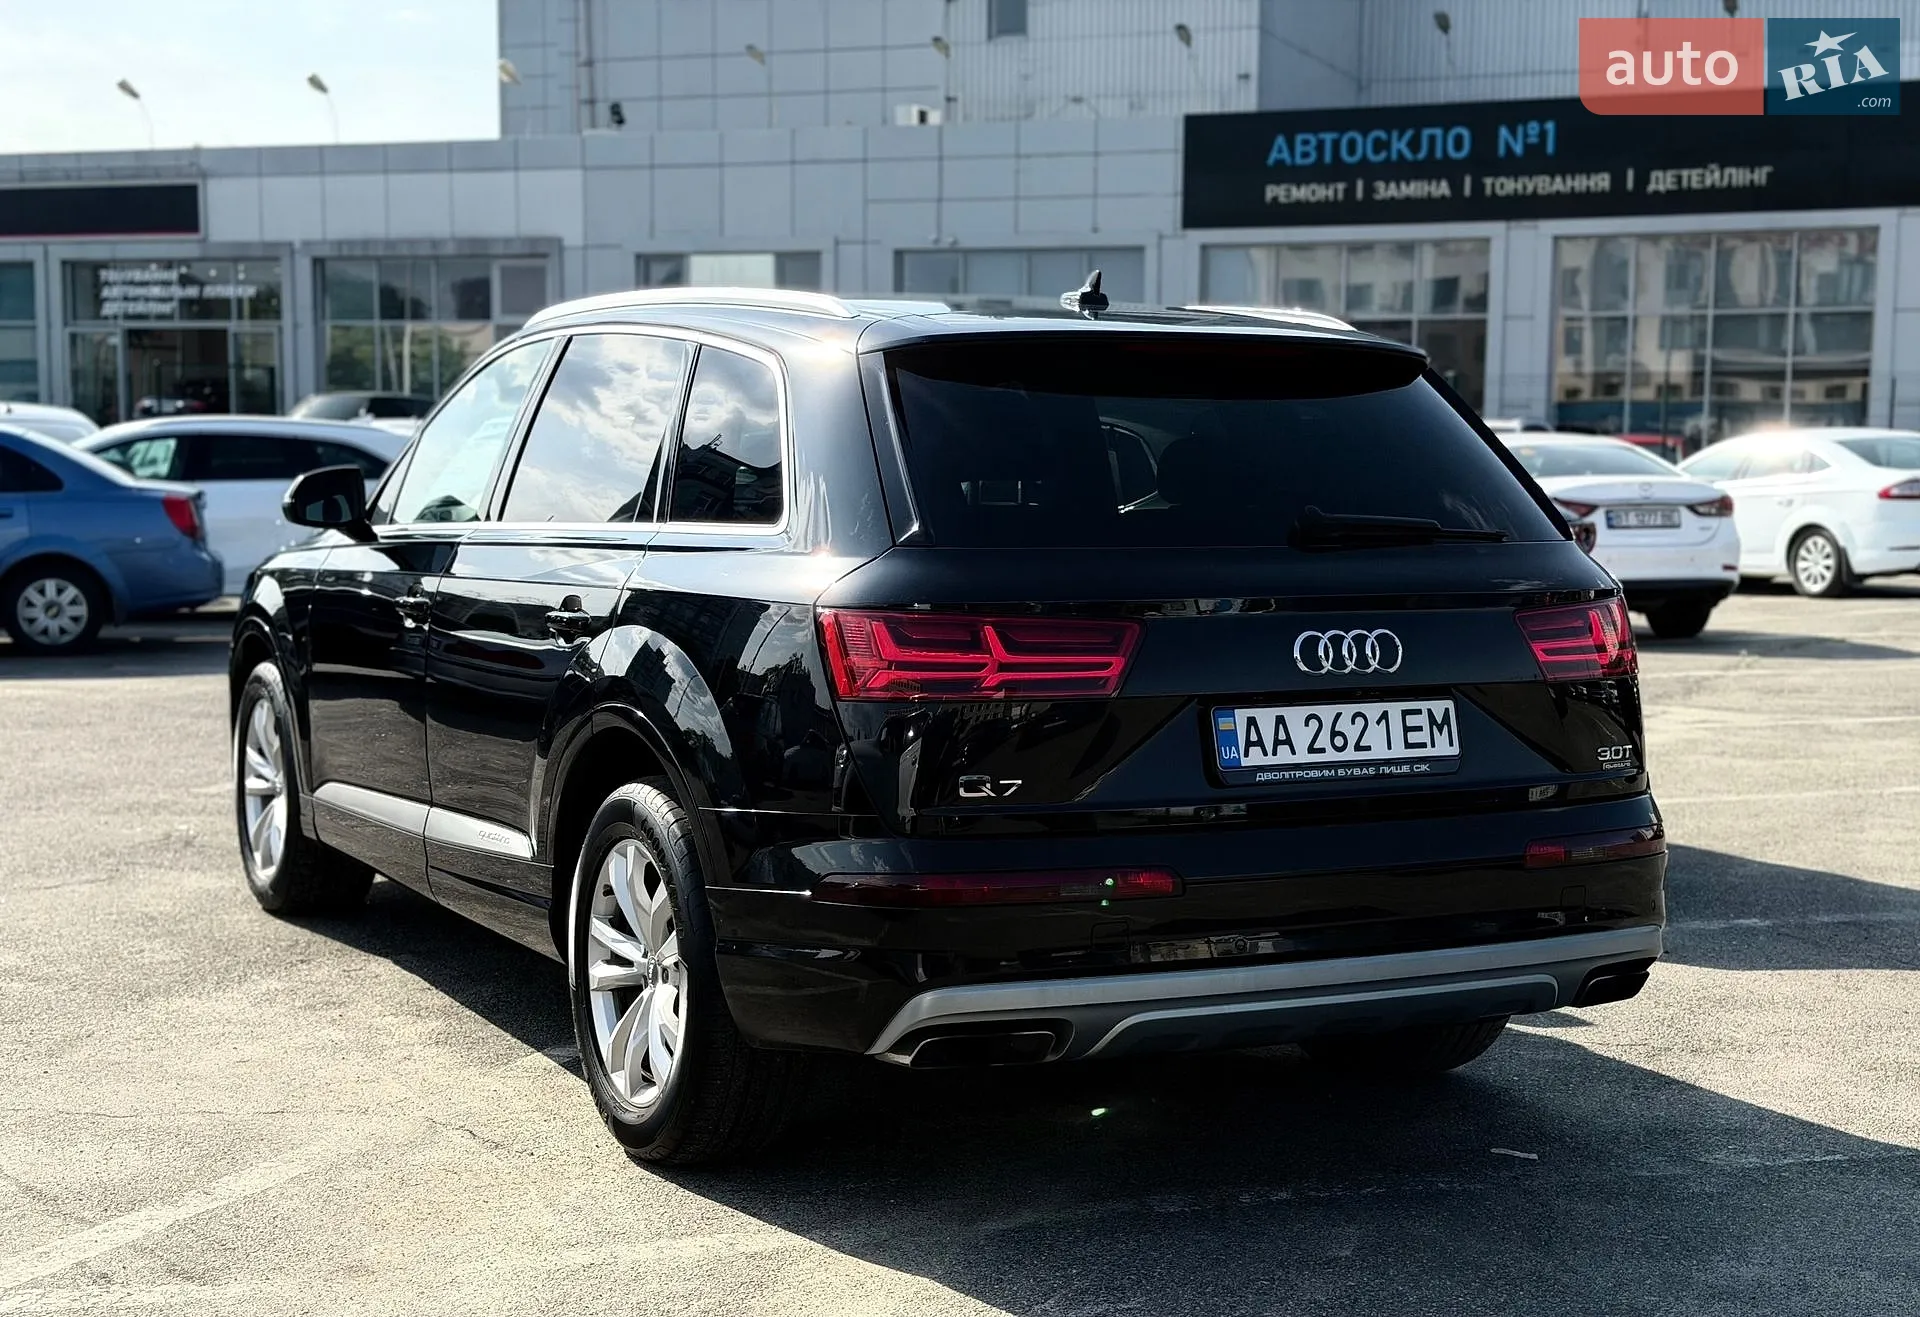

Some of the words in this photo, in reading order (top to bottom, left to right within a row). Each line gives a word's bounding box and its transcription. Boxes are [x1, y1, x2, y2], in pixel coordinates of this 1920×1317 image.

[1266, 126, 1472, 166] АВТОСКЛО
[1264, 181, 1348, 204] РЕМОНТ
[1372, 177, 1452, 200] ЗАМІНА
[1482, 172, 1612, 197] ТОНУВАННЯ
[1647, 164, 1774, 194] ДЕТЕЙЛІНГ
[1222, 745, 1239, 760] UA
[1243, 715, 1297, 758] AA
[1304, 709, 1393, 755] 2621
[1401, 706, 1455, 750] EM
[1256, 769, 1335, 782] ДВОЛІТРОВИМ
[1338, 767, 1376, 777] БУВАЄ
[1379, 765, 1411, 775] ЛИШЕ
[1413, 763, 1431, 773] СІК
